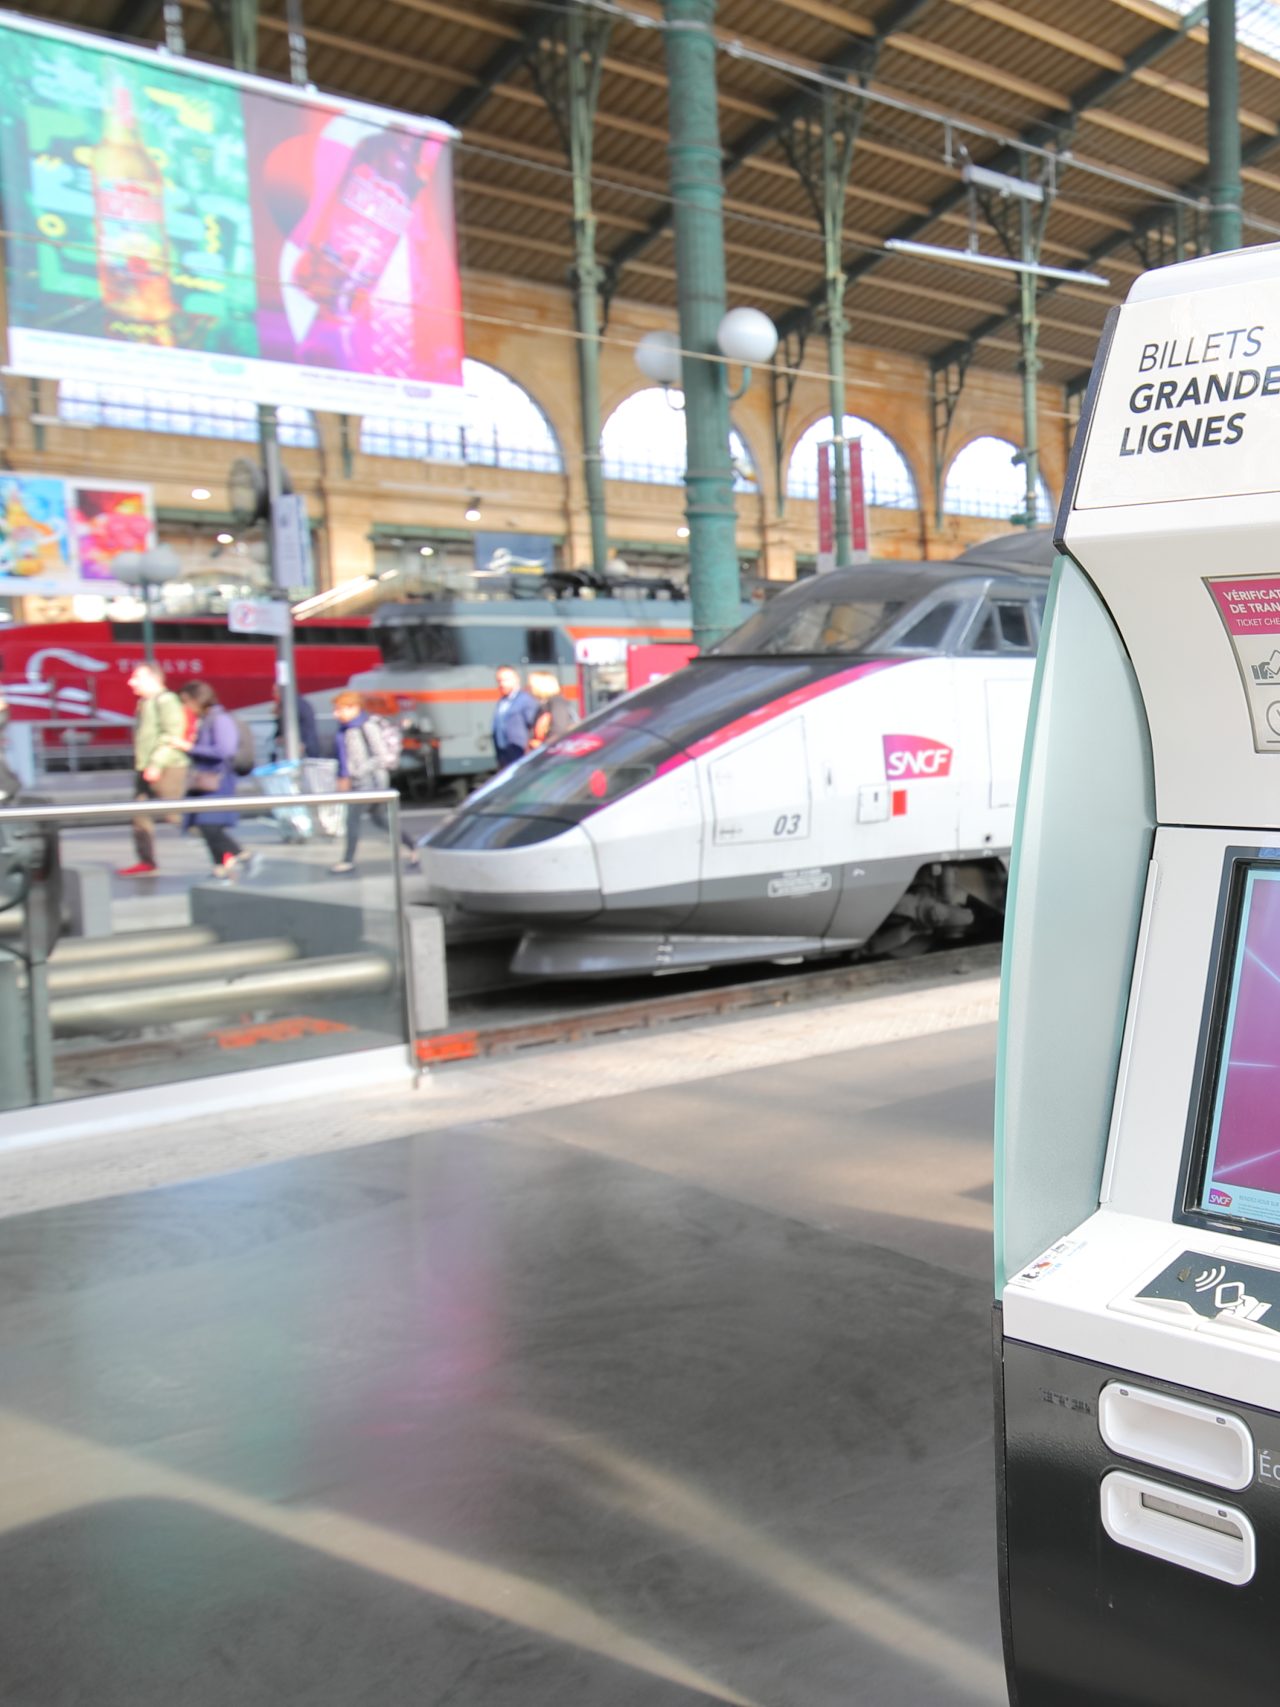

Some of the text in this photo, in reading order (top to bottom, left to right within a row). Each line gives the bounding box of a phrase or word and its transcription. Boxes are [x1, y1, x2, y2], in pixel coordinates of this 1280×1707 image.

[1138, 326, 1264, 372] BILLETS
[1119, 412, 1246, 457] LIGNES
[1229, 603, 1247, 614] DE
[1236, 618, 1262, 627] TICKET
[887, 749, 950, 776] SNCF
[773, 814, 801, 836] 03
[1210, 1194, 1231, 1206] SNCF
